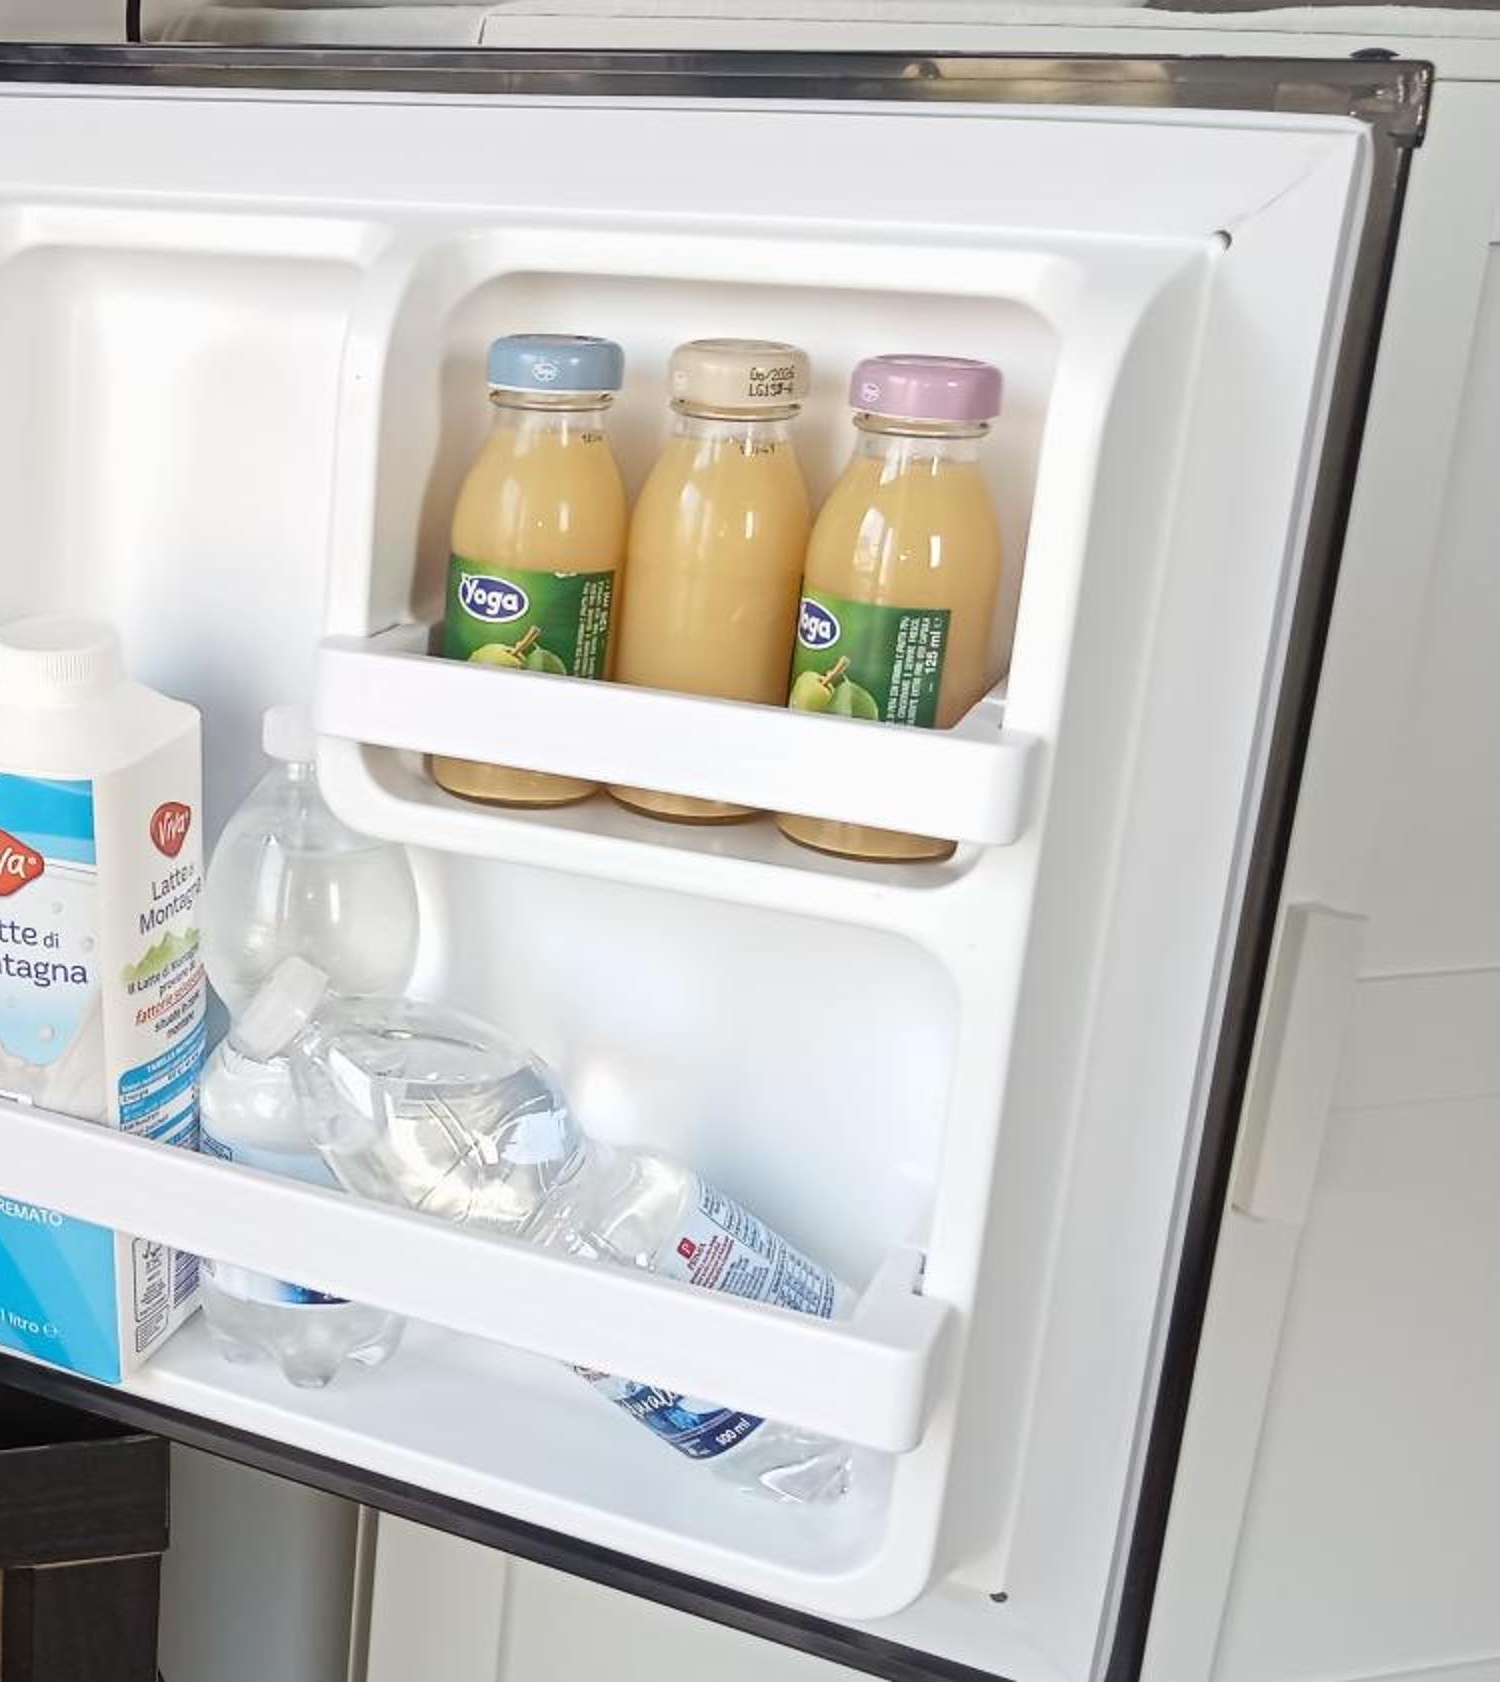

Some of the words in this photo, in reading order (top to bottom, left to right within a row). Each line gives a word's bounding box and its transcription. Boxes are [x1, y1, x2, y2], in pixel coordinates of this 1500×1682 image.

[465, 579, 519, 615] Yoga
[800, 603, 831, 642] oga
[930, 631, 941, 648] ml
[925, 651, 938, 674] 125
[157, 812, 187, 847] Viva
[151, 866, 188, 901] Latte
[43, 932, 60, 949] di
[8, 1312, 39, 1333] litro
[734, 1417, 751, 1435] ml
